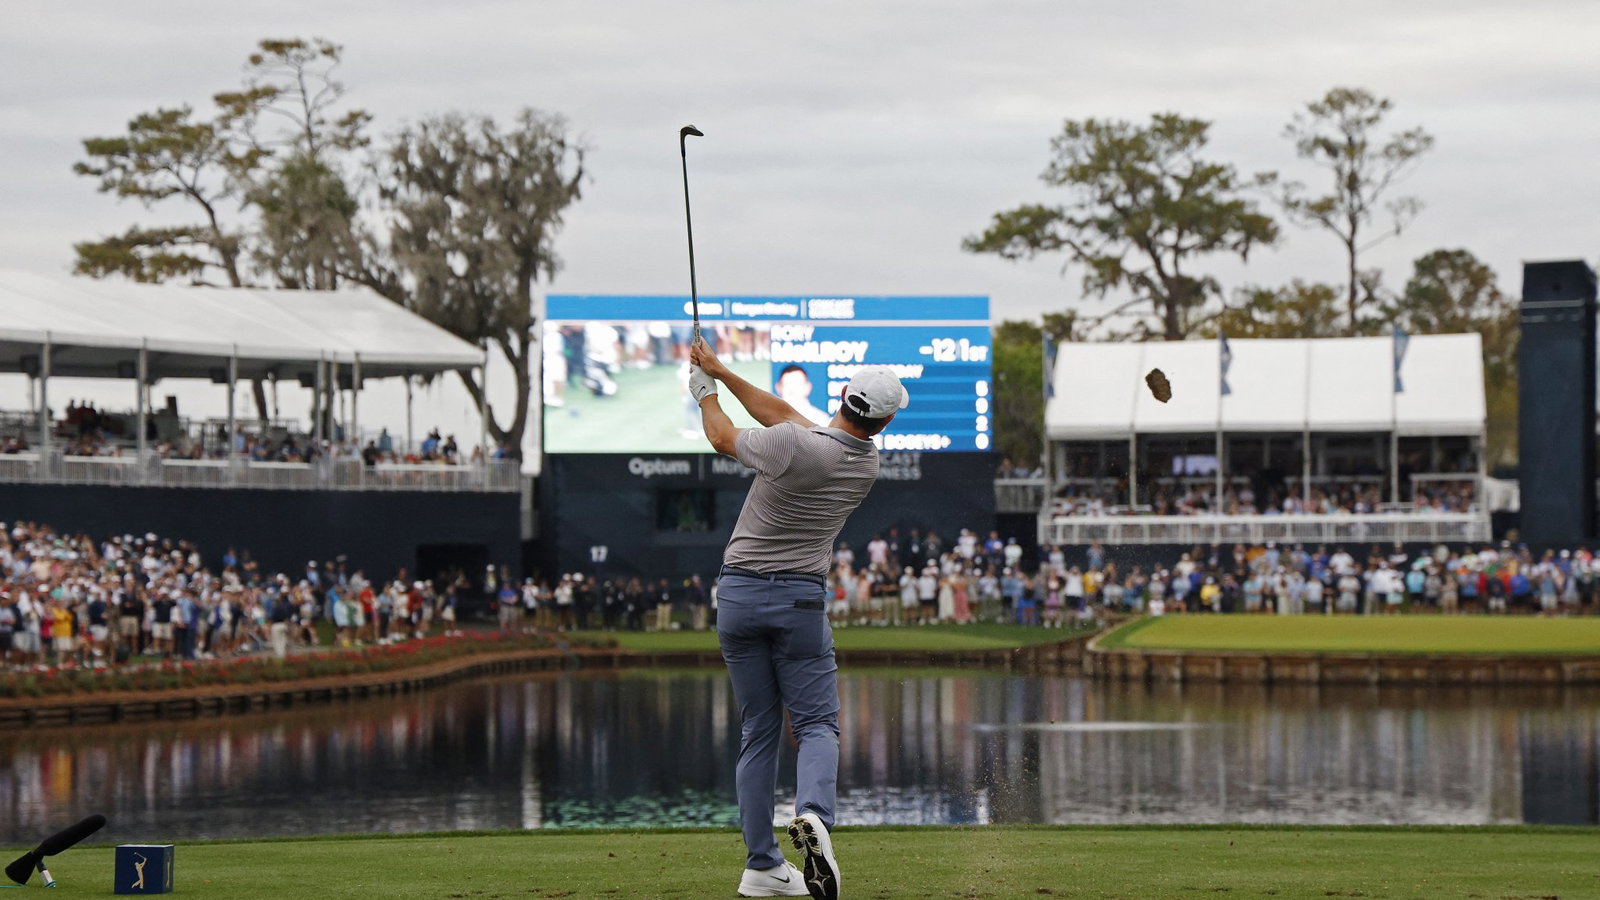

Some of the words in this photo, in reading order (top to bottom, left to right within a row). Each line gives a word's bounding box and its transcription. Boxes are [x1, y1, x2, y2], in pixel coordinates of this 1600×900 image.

[879, 452, 921, 466] CAST
[628, 458, 691, 478] Optum
[712, 458, 751, 477] Morg
[877, 466, 922, 481] NESS
[590, 546, 607, 562] 17
